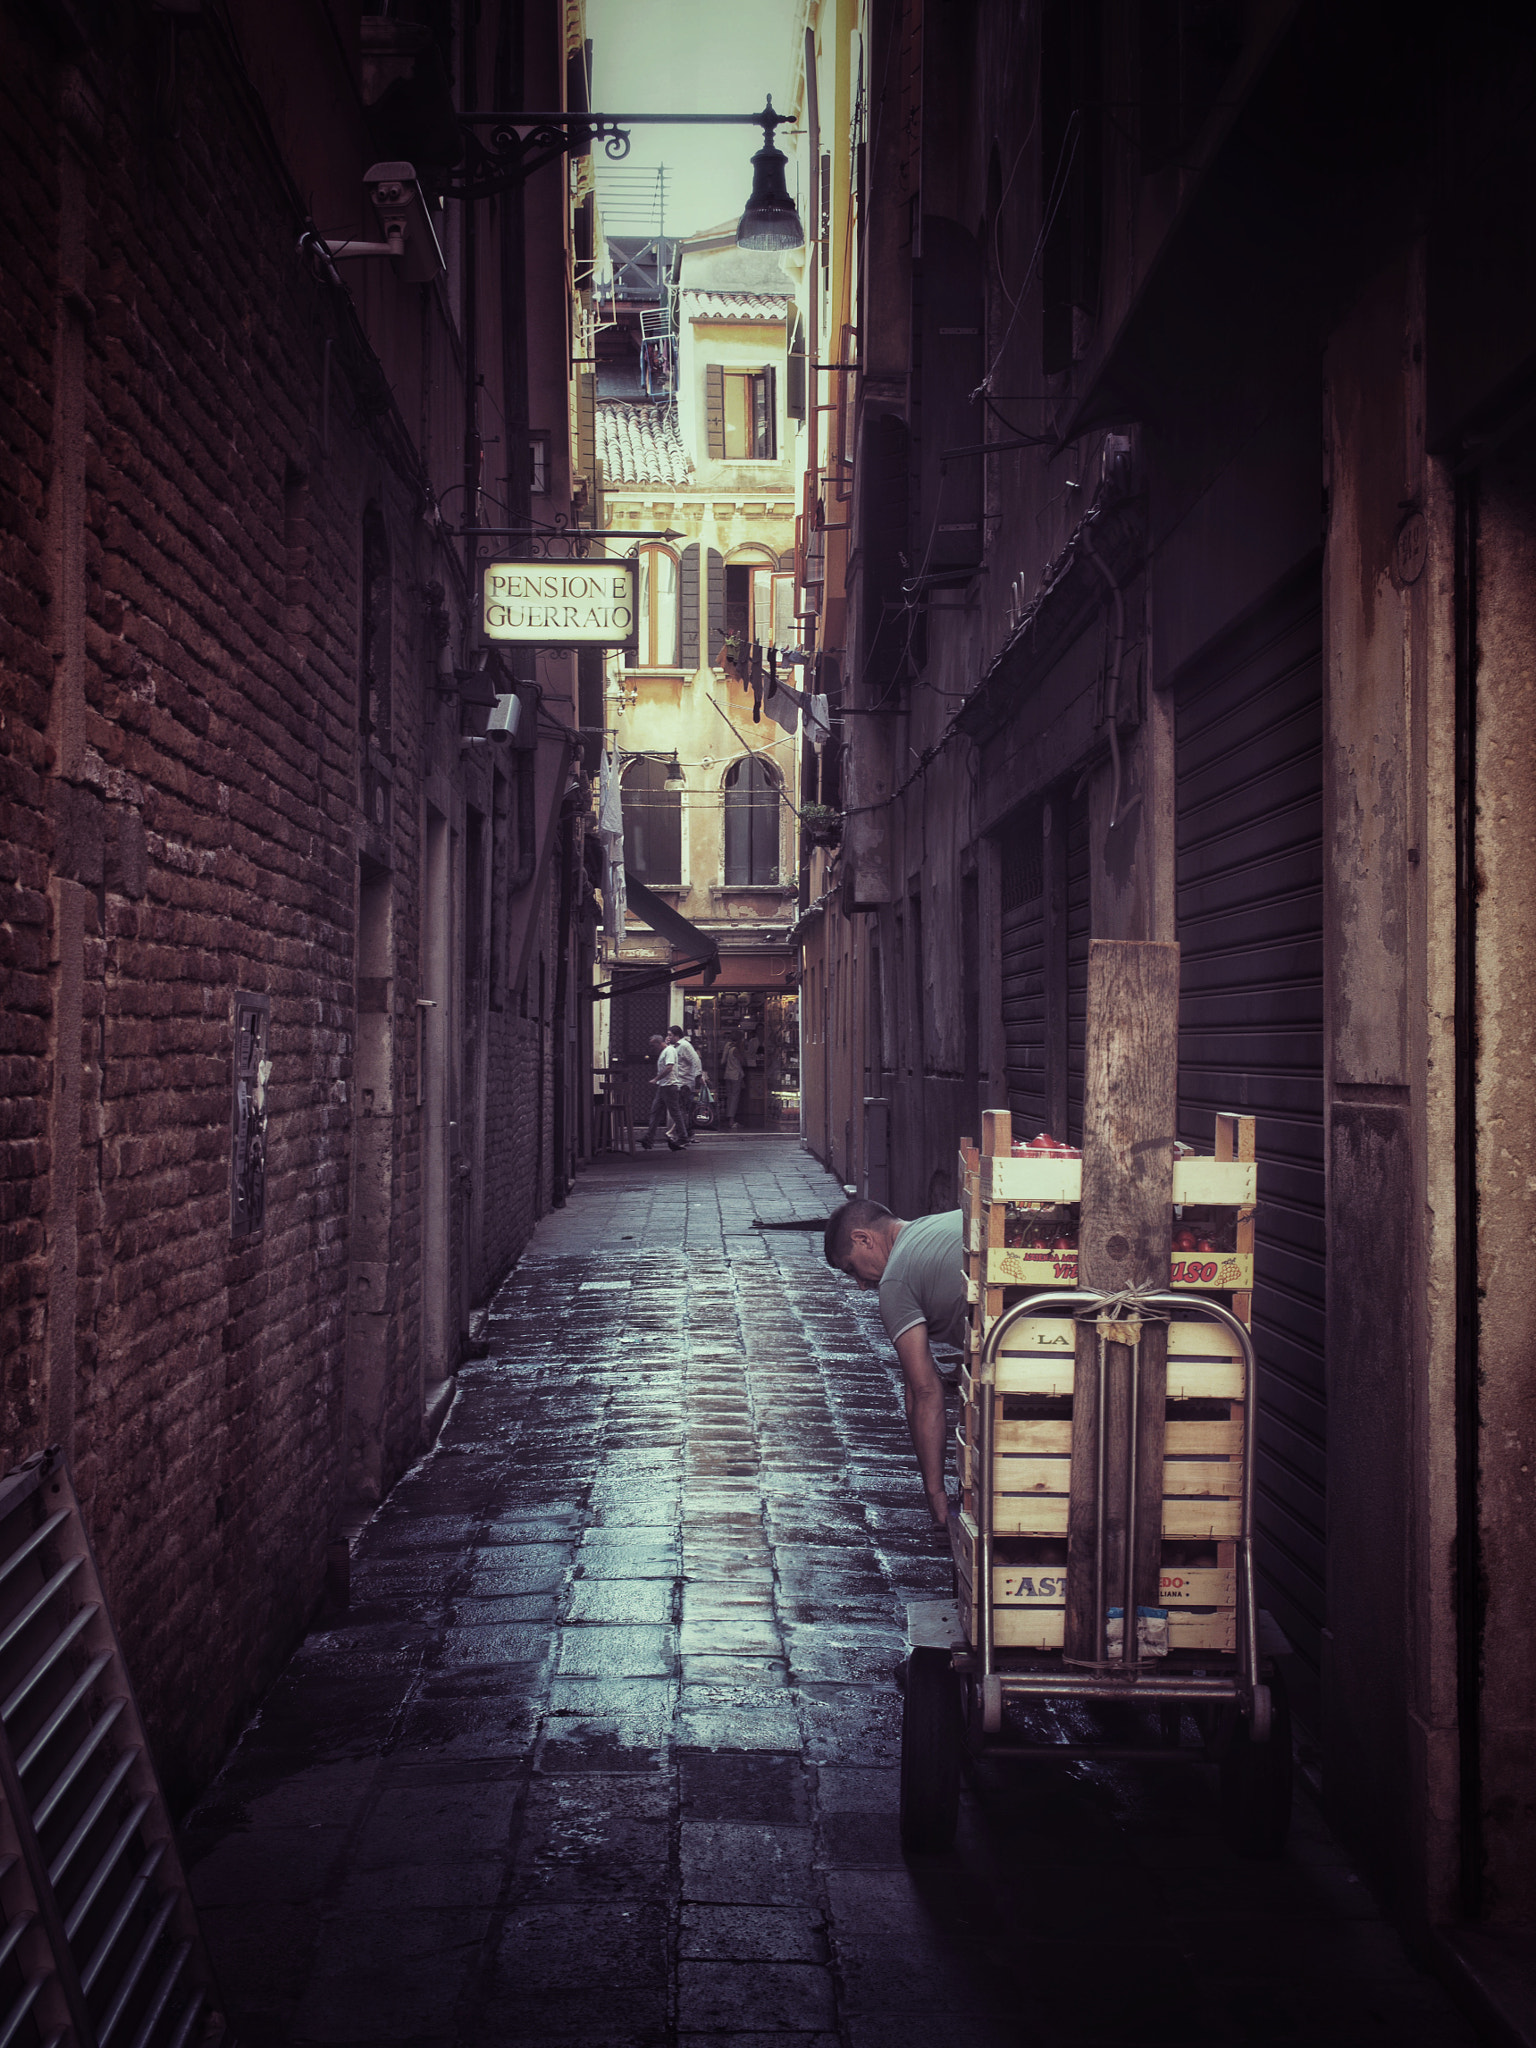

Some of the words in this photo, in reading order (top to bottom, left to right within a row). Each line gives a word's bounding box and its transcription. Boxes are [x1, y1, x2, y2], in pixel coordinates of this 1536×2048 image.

[490, 576, 627, 599] PENSIONE
[486, 604, 632, 628] GUERRATO
[1037, 1334, 1070, 1346] LA
[1014, 1577, 1067, 1597] AST
